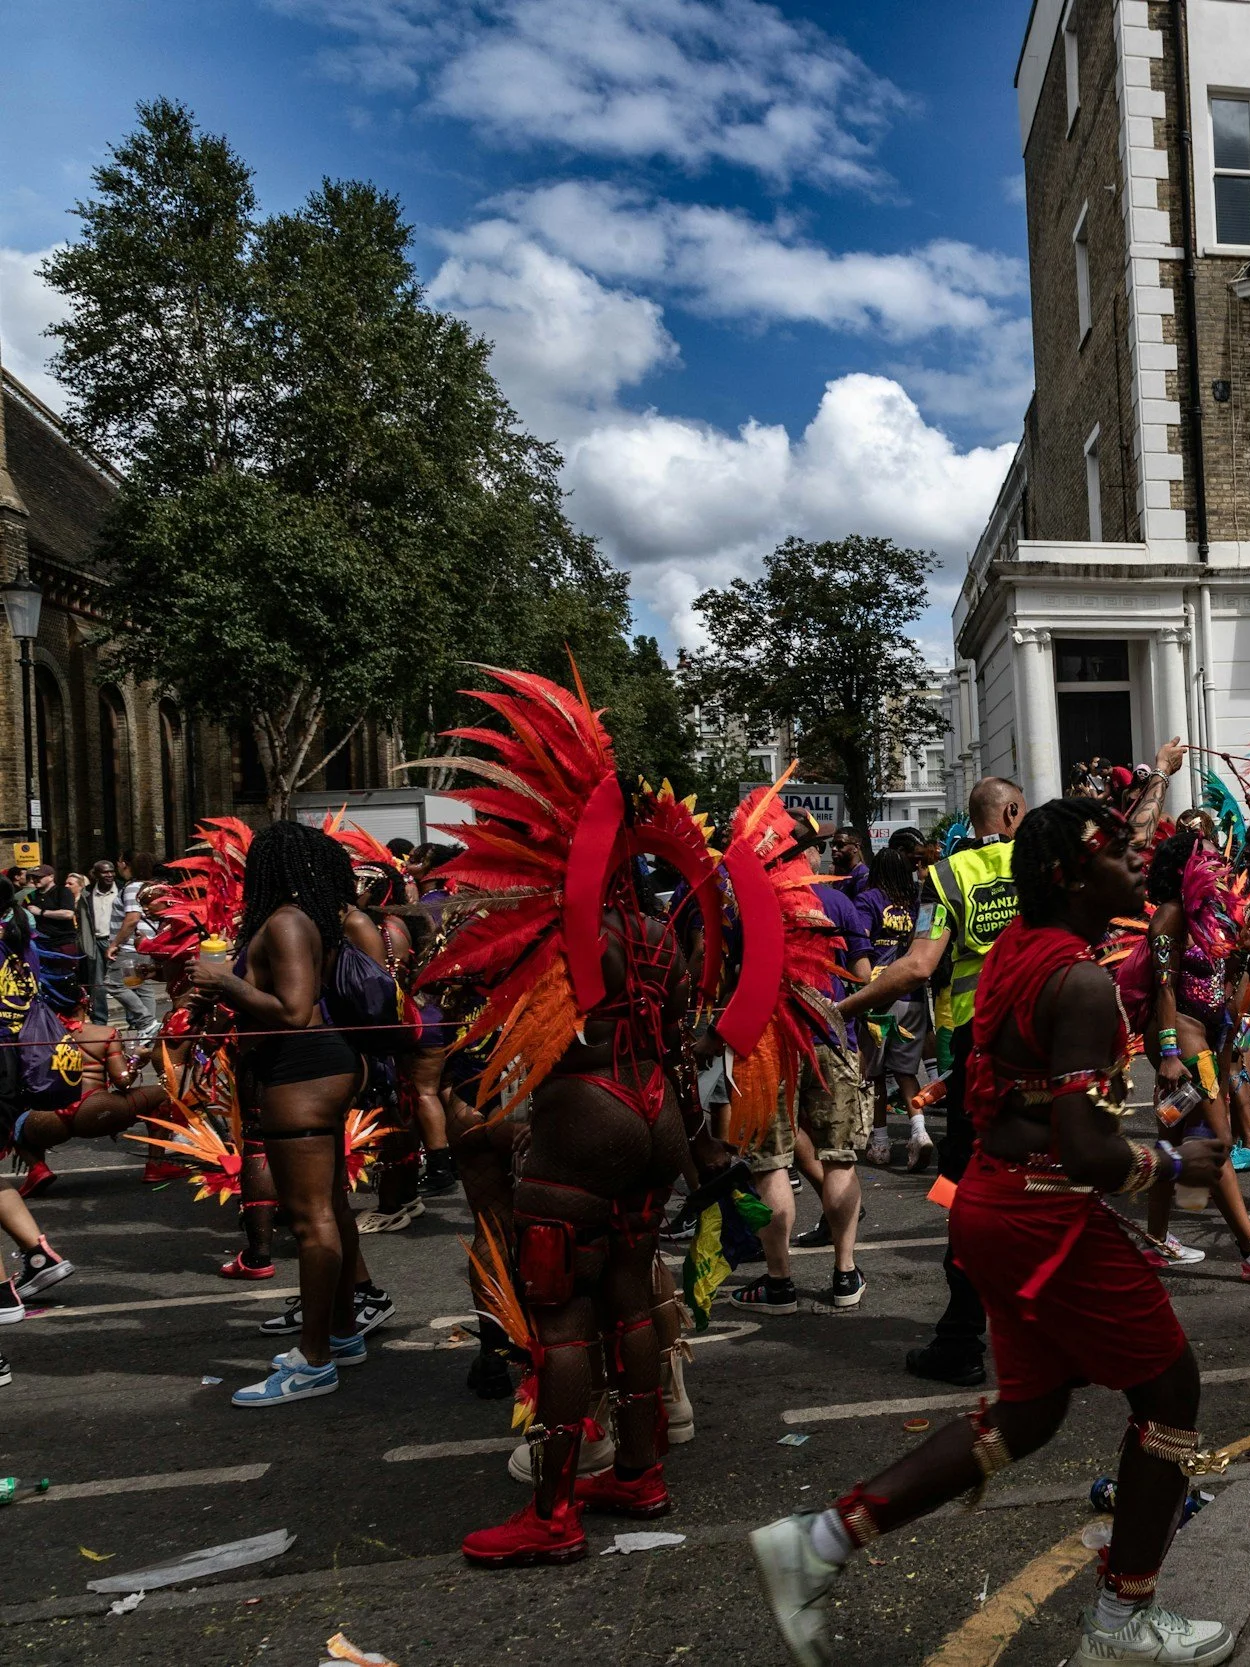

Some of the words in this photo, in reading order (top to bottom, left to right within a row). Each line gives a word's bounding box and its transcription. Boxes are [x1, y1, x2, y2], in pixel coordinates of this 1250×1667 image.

[816, 813, 833, 821] HIRE
[976, 909, 1020, 922] GROUN
[975, 919, 1013, 933] SUPPO
